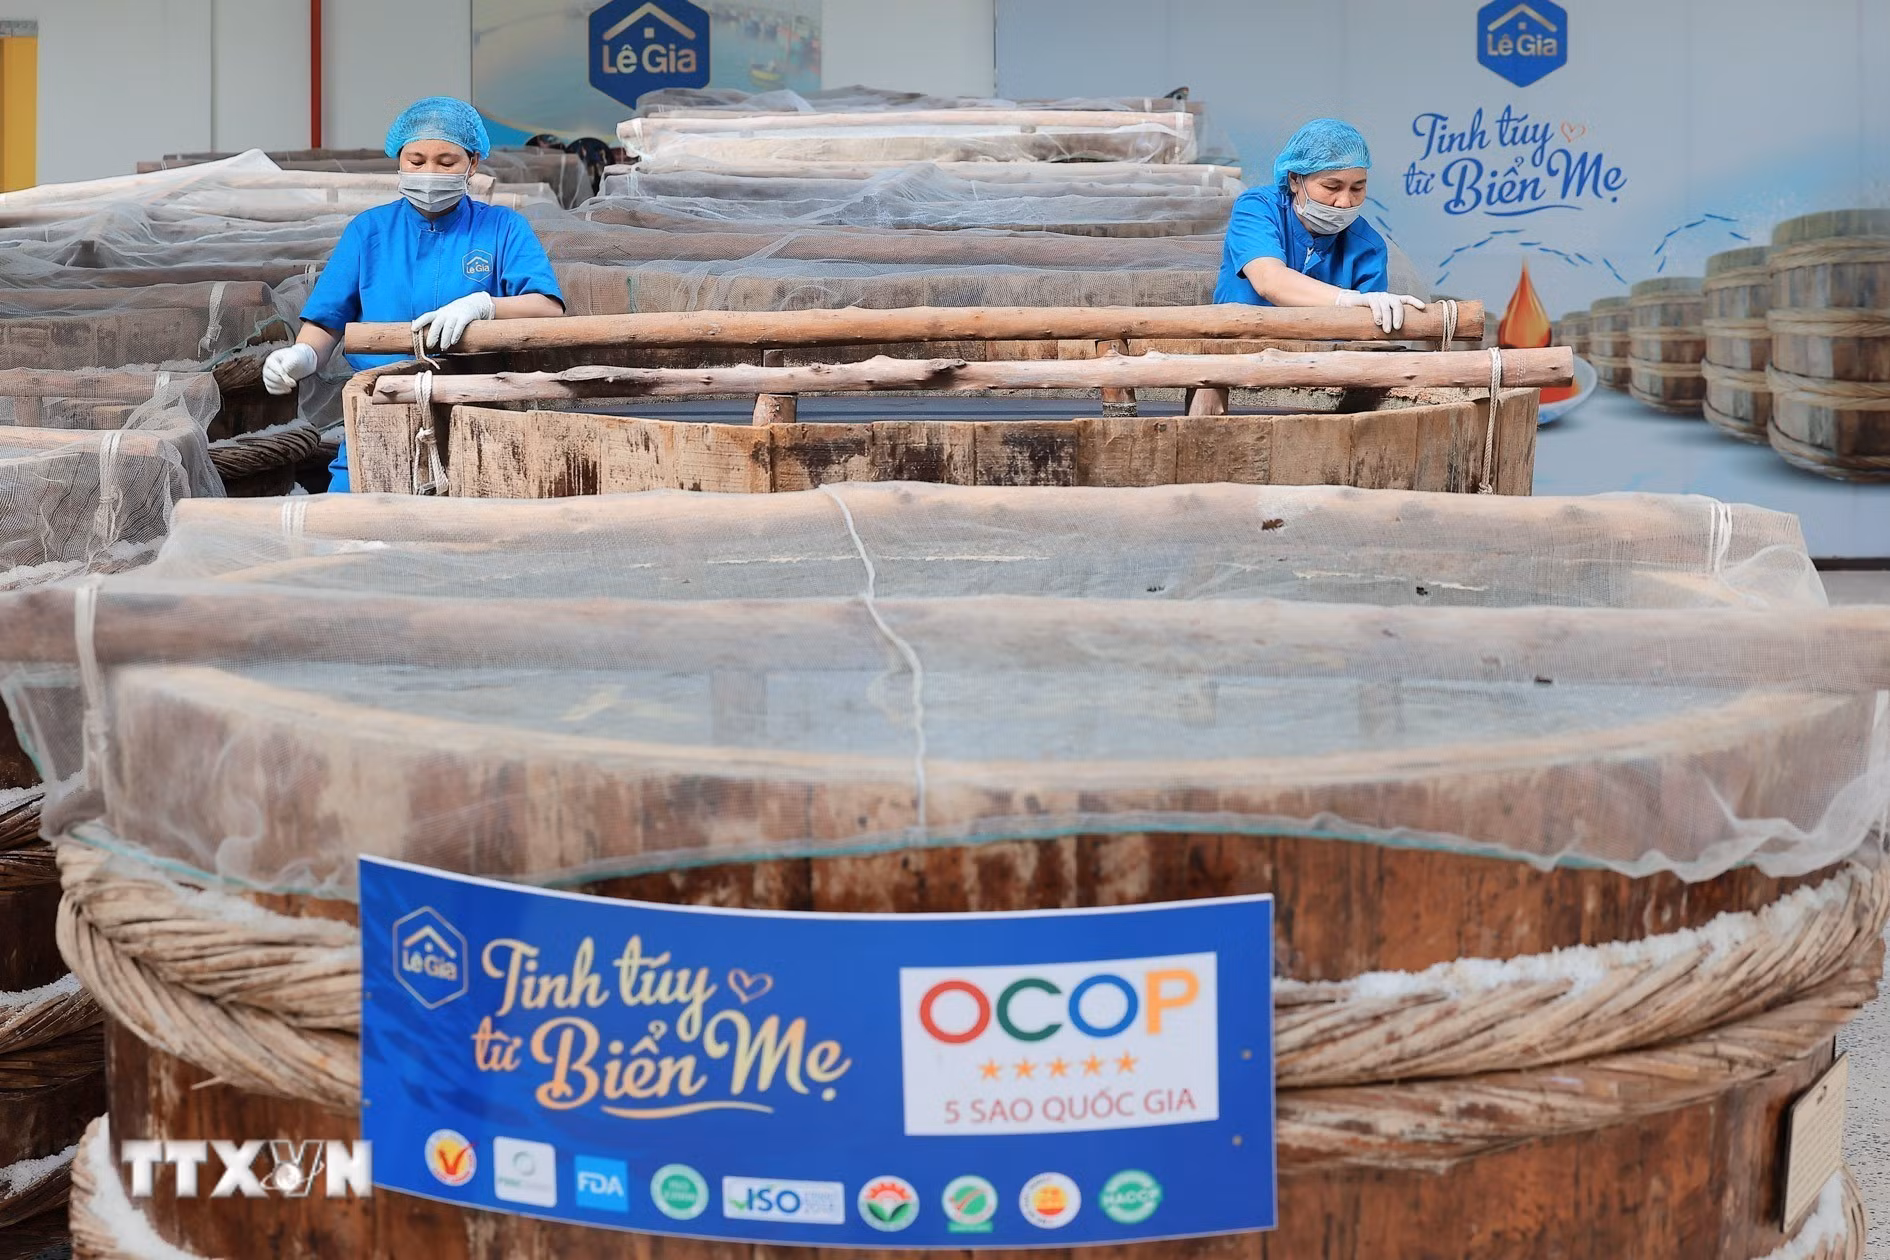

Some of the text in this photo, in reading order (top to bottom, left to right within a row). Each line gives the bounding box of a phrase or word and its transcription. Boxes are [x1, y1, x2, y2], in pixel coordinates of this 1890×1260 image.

[602, 43, 697, 74] Lê Gia
[1487, 33, 1558, 56] Lê Gia
[1412, 104, 1555, 167] Tinh túy
[1403, 149, 1628, 215] từ Biển Mẹ
[475, 264, 490, 272] Gia
[402, 949, 458, 981] Lê Gia
[481, 934, 717, 1043] Tinh túy
[919, 968, 1200, 1045] OCOP
[471, 1009, 853, 1110] từ Biển Mẹ
[944, 1085, 1197, 1124] 5 SAO QUỐC GIA
[577, 1170, 625, 1197] FDA
[746, 1187, 802, 1214] ISO
